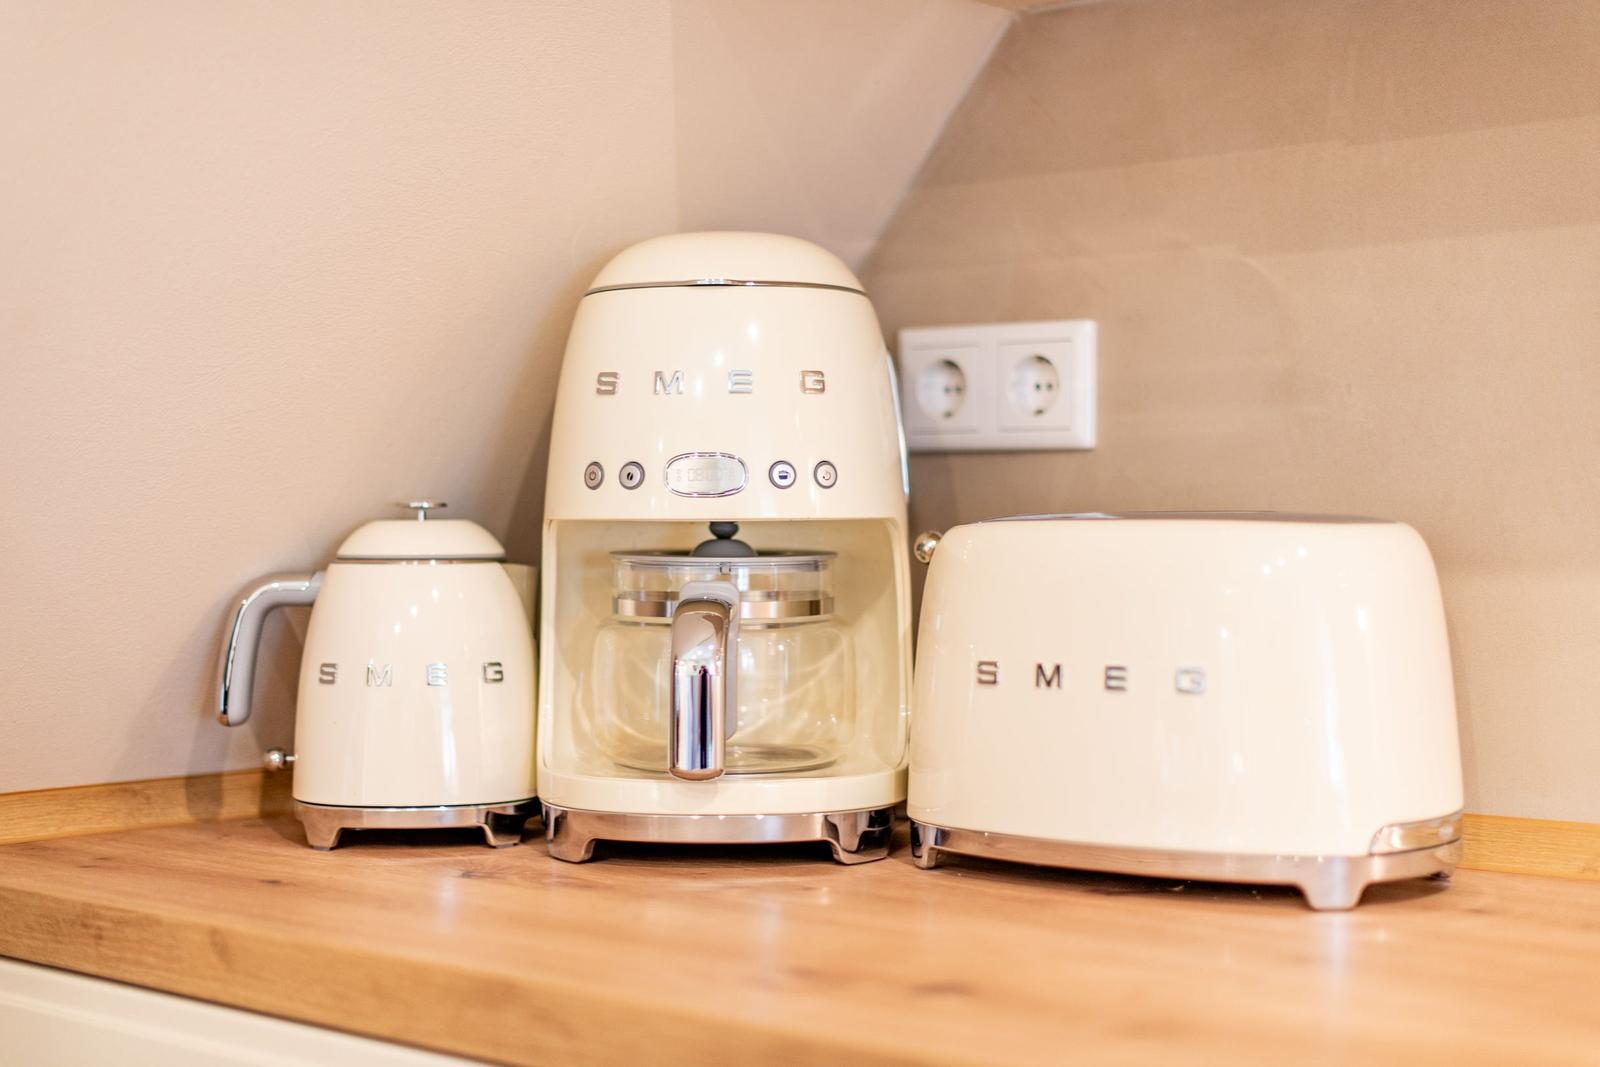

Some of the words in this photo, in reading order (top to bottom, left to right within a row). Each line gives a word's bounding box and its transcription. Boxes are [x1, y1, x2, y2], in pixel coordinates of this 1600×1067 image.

[596, 369, 826, 396] SMEG
[318, 661, 504, 687] SMEG
[976, 660, 1207, 695] SMEG
